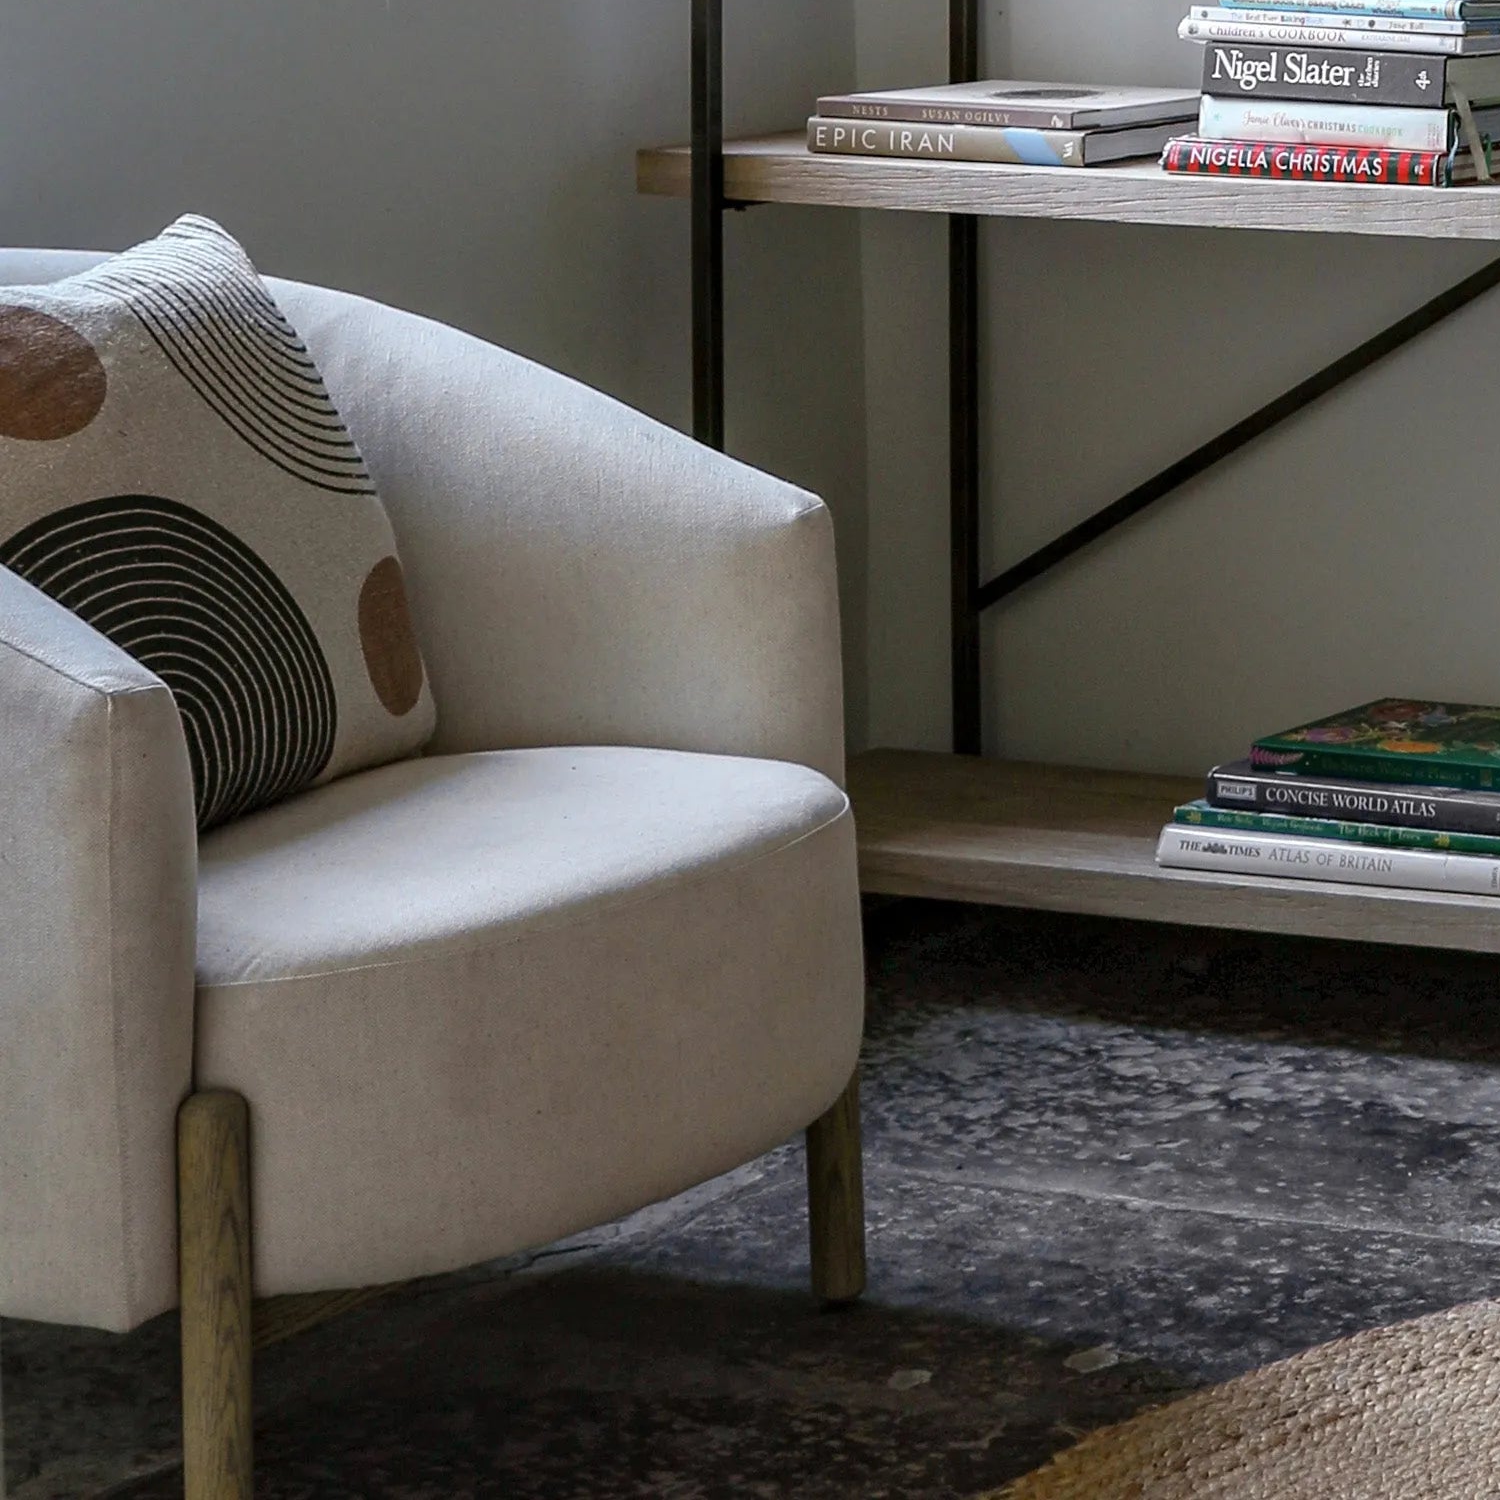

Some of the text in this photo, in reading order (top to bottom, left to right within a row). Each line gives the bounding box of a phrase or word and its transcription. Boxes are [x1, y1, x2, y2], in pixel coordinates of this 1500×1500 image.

[1338, 0, 1366, 10] Cakes
[1280, 14, 1306, 26] Baking
[1208, 25, 1347, 43] Children's COOKBOOK
[1211, 49, 1356, 90] Nigel Slater
[851, 104, 1011, 124] NESTS SUSAN OGILVY
[1241, 109, 1269, 126] Jamie
[1307, 120, 1404, 137] CHRISTMAS COOKBOOK
[815, 126, 955, 153] EPIC IRAN
[1189, 147, 1268, 169] NIGELLA
[1275, 151, 1384, 176] CHRISTMAS
[1265, 786, 1437, 818] CONCISE WORLD ATLAS
[1179, 840, 1261, 859] THE TIMES
[1268, 848, 1394, 873] ATLAS OF BRITAIN
